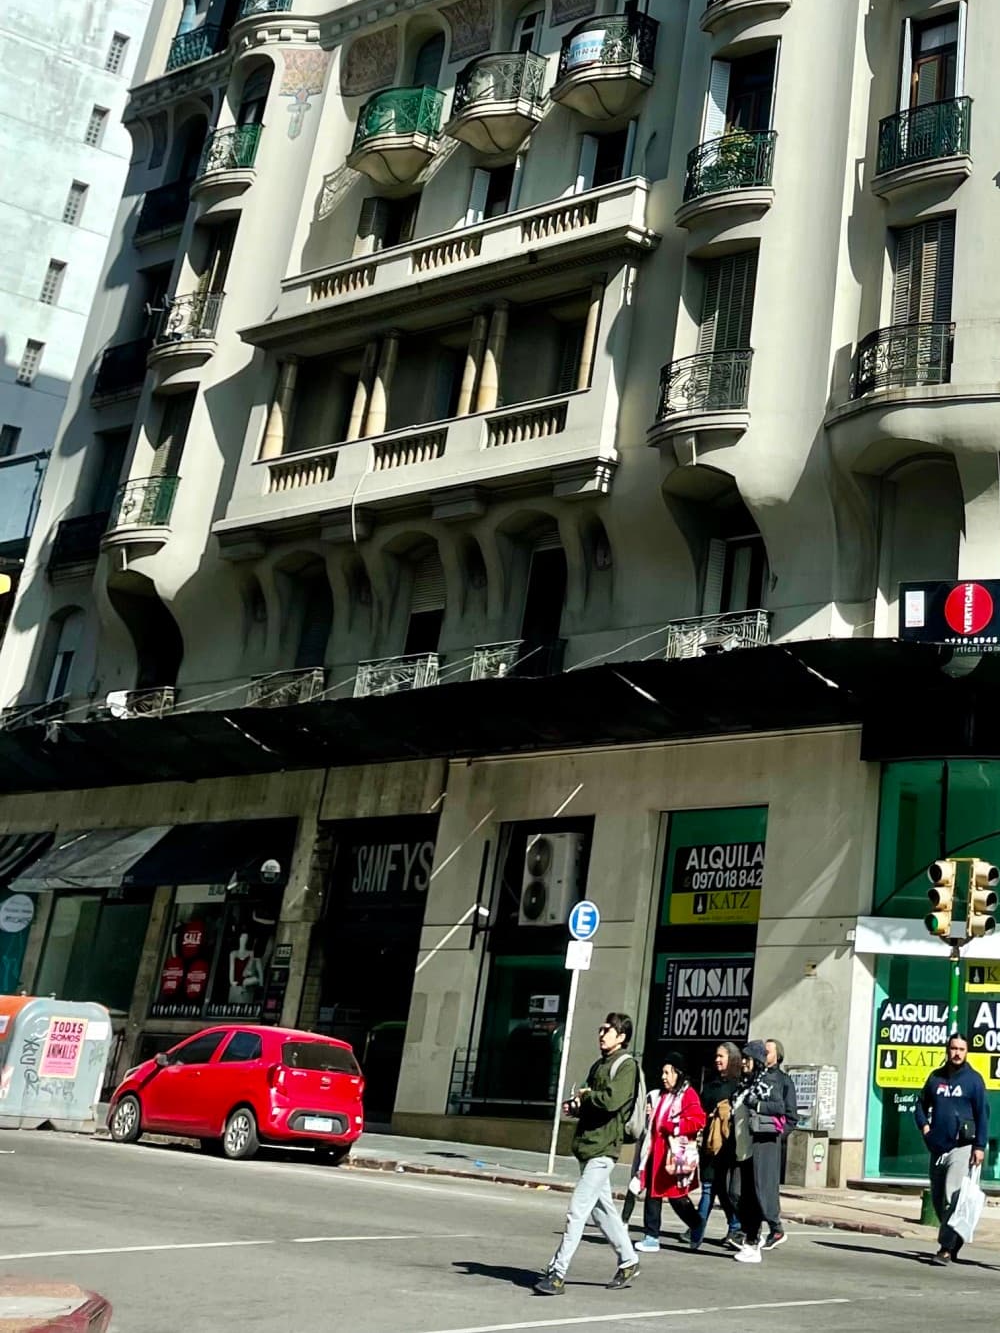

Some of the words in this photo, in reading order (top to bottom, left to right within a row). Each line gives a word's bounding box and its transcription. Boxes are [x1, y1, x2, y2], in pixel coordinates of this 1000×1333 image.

[964, 583, 974, 633] VERTICAL
[352, 841, 434, 893] SANFYS
[686, 844, 764, 870] ALQUILA
[709, 891, 750, 910] KATZ
[576, 906, 593, 931] E
[183, 932, 202, 945] SALE
[677, 967, 752, 997] KOSAK
[674, 1008, 698, 1036] 092
[701, 1008, 722, 1036] 110
[724, 1008, 749, 1036] 025
[890, 1024, 911, 1043] 097
[912, 1025, 948, 1044] 01884
[50, 1034, 81, 1042] SOMOS
